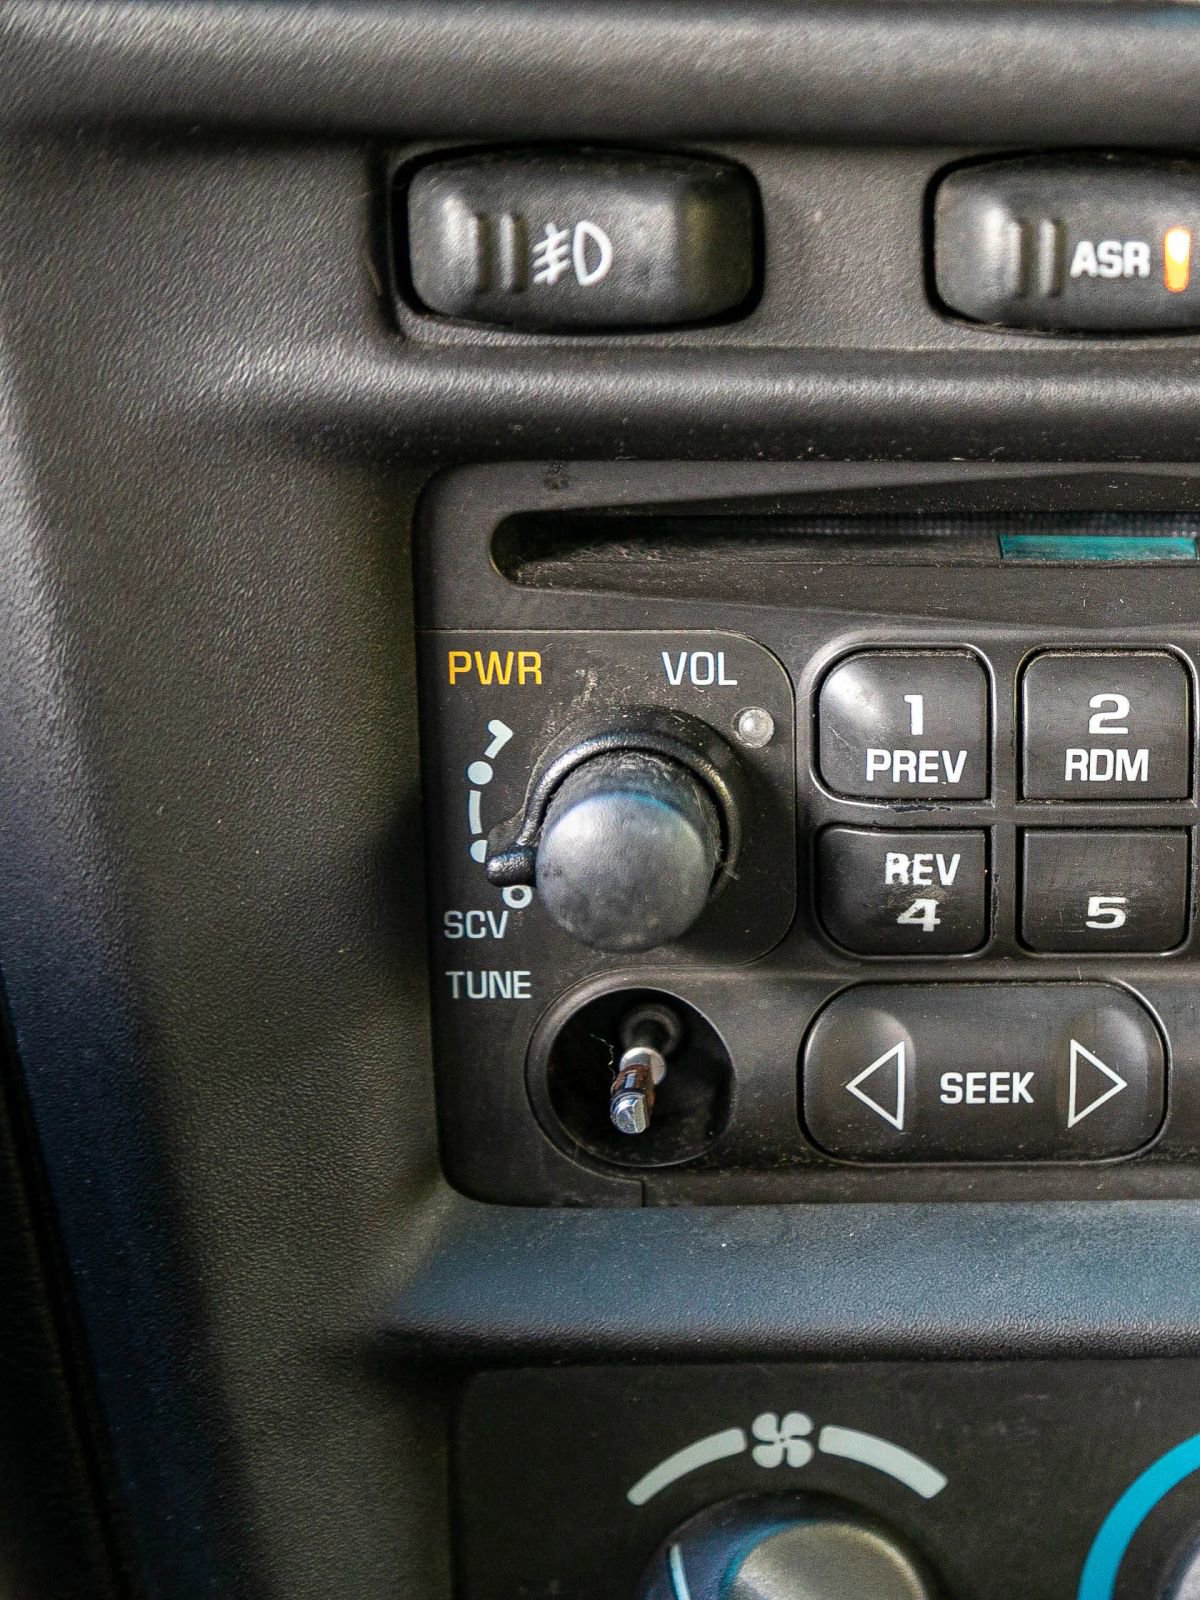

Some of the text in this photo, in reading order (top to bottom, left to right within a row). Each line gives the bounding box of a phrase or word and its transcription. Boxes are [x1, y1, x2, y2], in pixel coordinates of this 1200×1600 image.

[1070, 240, 1151, 278] ASR
[448, 651, 542, 685] PWR
[661, 651, 738, 686] VOL
[904, 694, 924, 736] 1
[1088, 693, 1131, 735] 2
[866, 748, 968, 783] PREV
[1064, 748, 1149, 782] RDM
[884, 852, 961, 886] REV
[443, 909, 509, 939] SCV
[897, 898, 941, 932] 4
[1085, 896, 1127, 929] 5
[445, 970, 532, 999] TUNE
[940, 1071, 1035, 1104] SEEK
